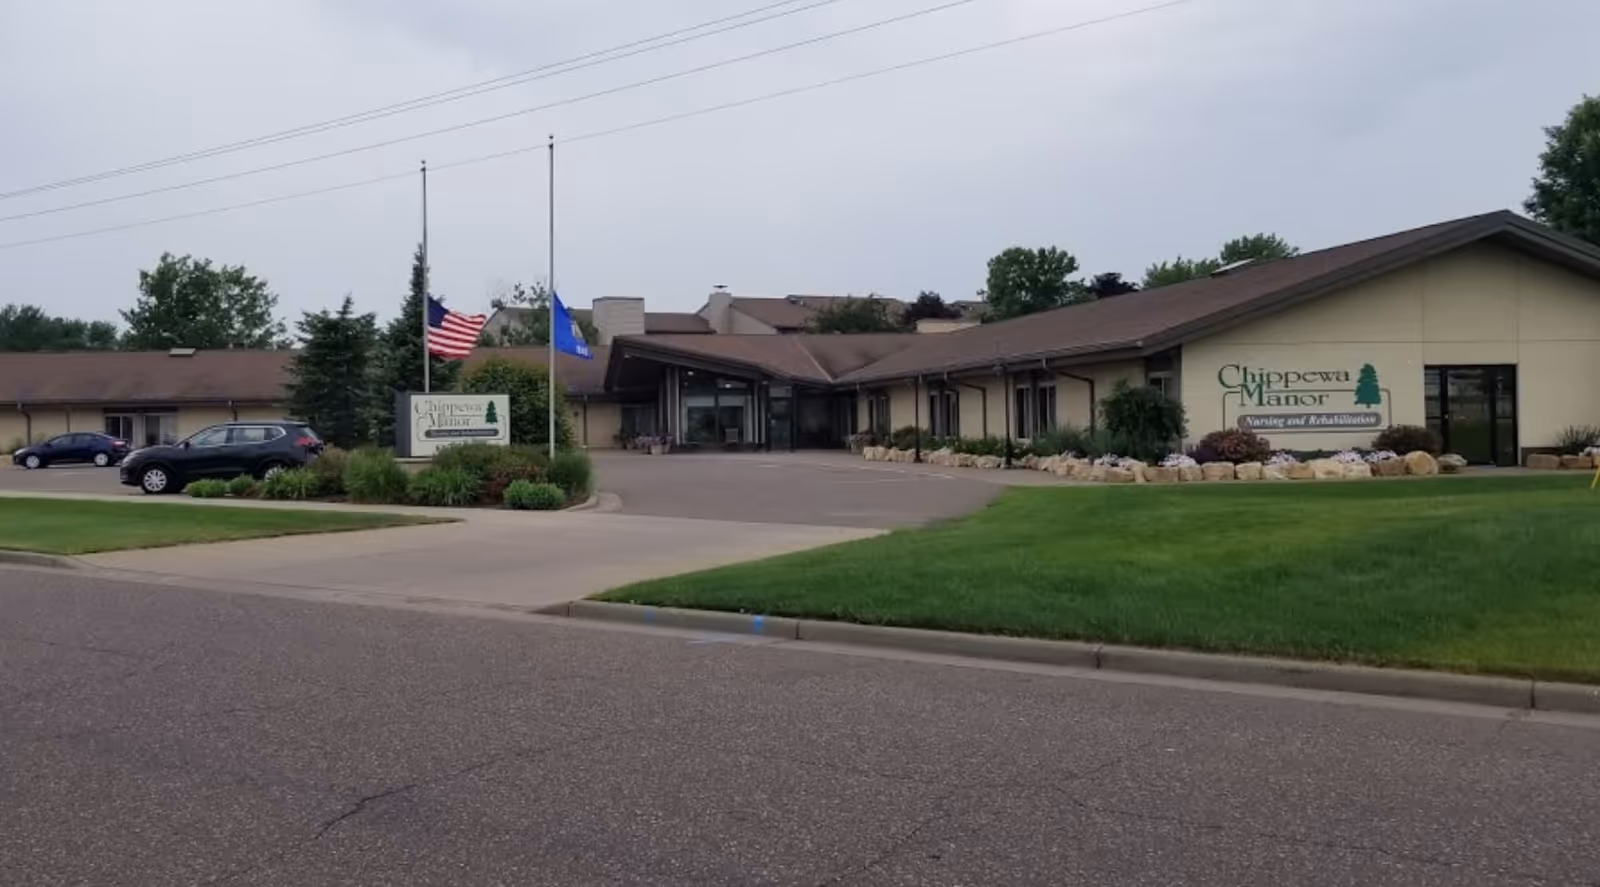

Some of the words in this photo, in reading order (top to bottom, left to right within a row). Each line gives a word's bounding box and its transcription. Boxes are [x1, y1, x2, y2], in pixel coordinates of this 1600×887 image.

[1218, 364, 1350, 388] Chippewa
[1240, 383, 1329, 407] Manor
[1246, 416, 1285, 427] Nursing
[1286, 415, 1306, 425] and
[1308, 413, 1377, 425] Rehabilitation
